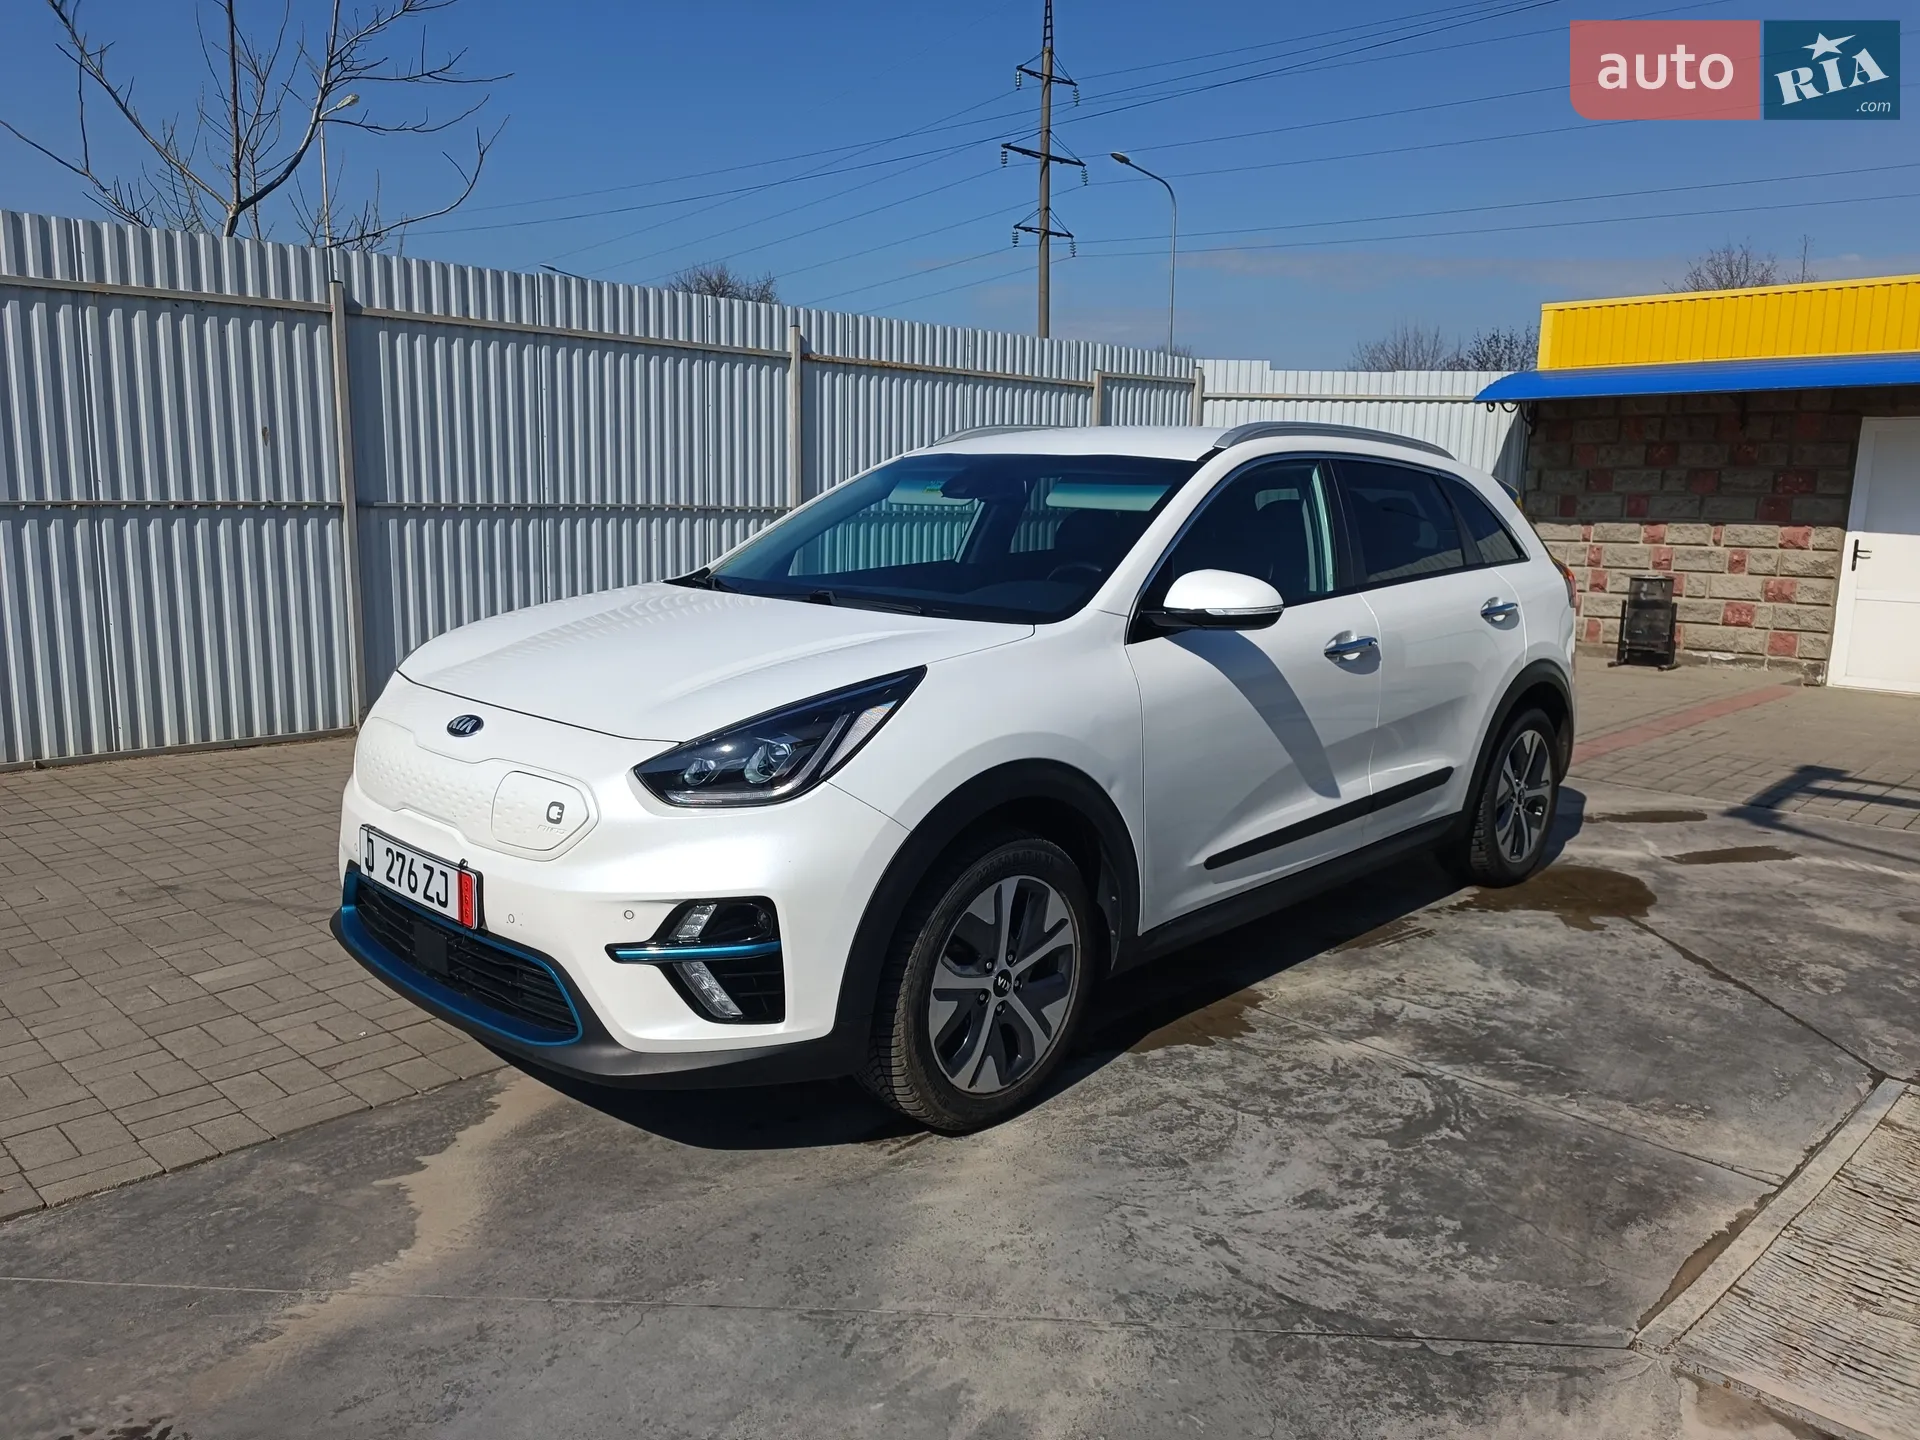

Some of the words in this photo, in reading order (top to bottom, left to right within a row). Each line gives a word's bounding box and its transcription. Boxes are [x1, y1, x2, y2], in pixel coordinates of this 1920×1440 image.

[449, 717, 477, 733] KIA
[385, 847, 418, 893] 276
[423, 863, 449, 908] ZJ
